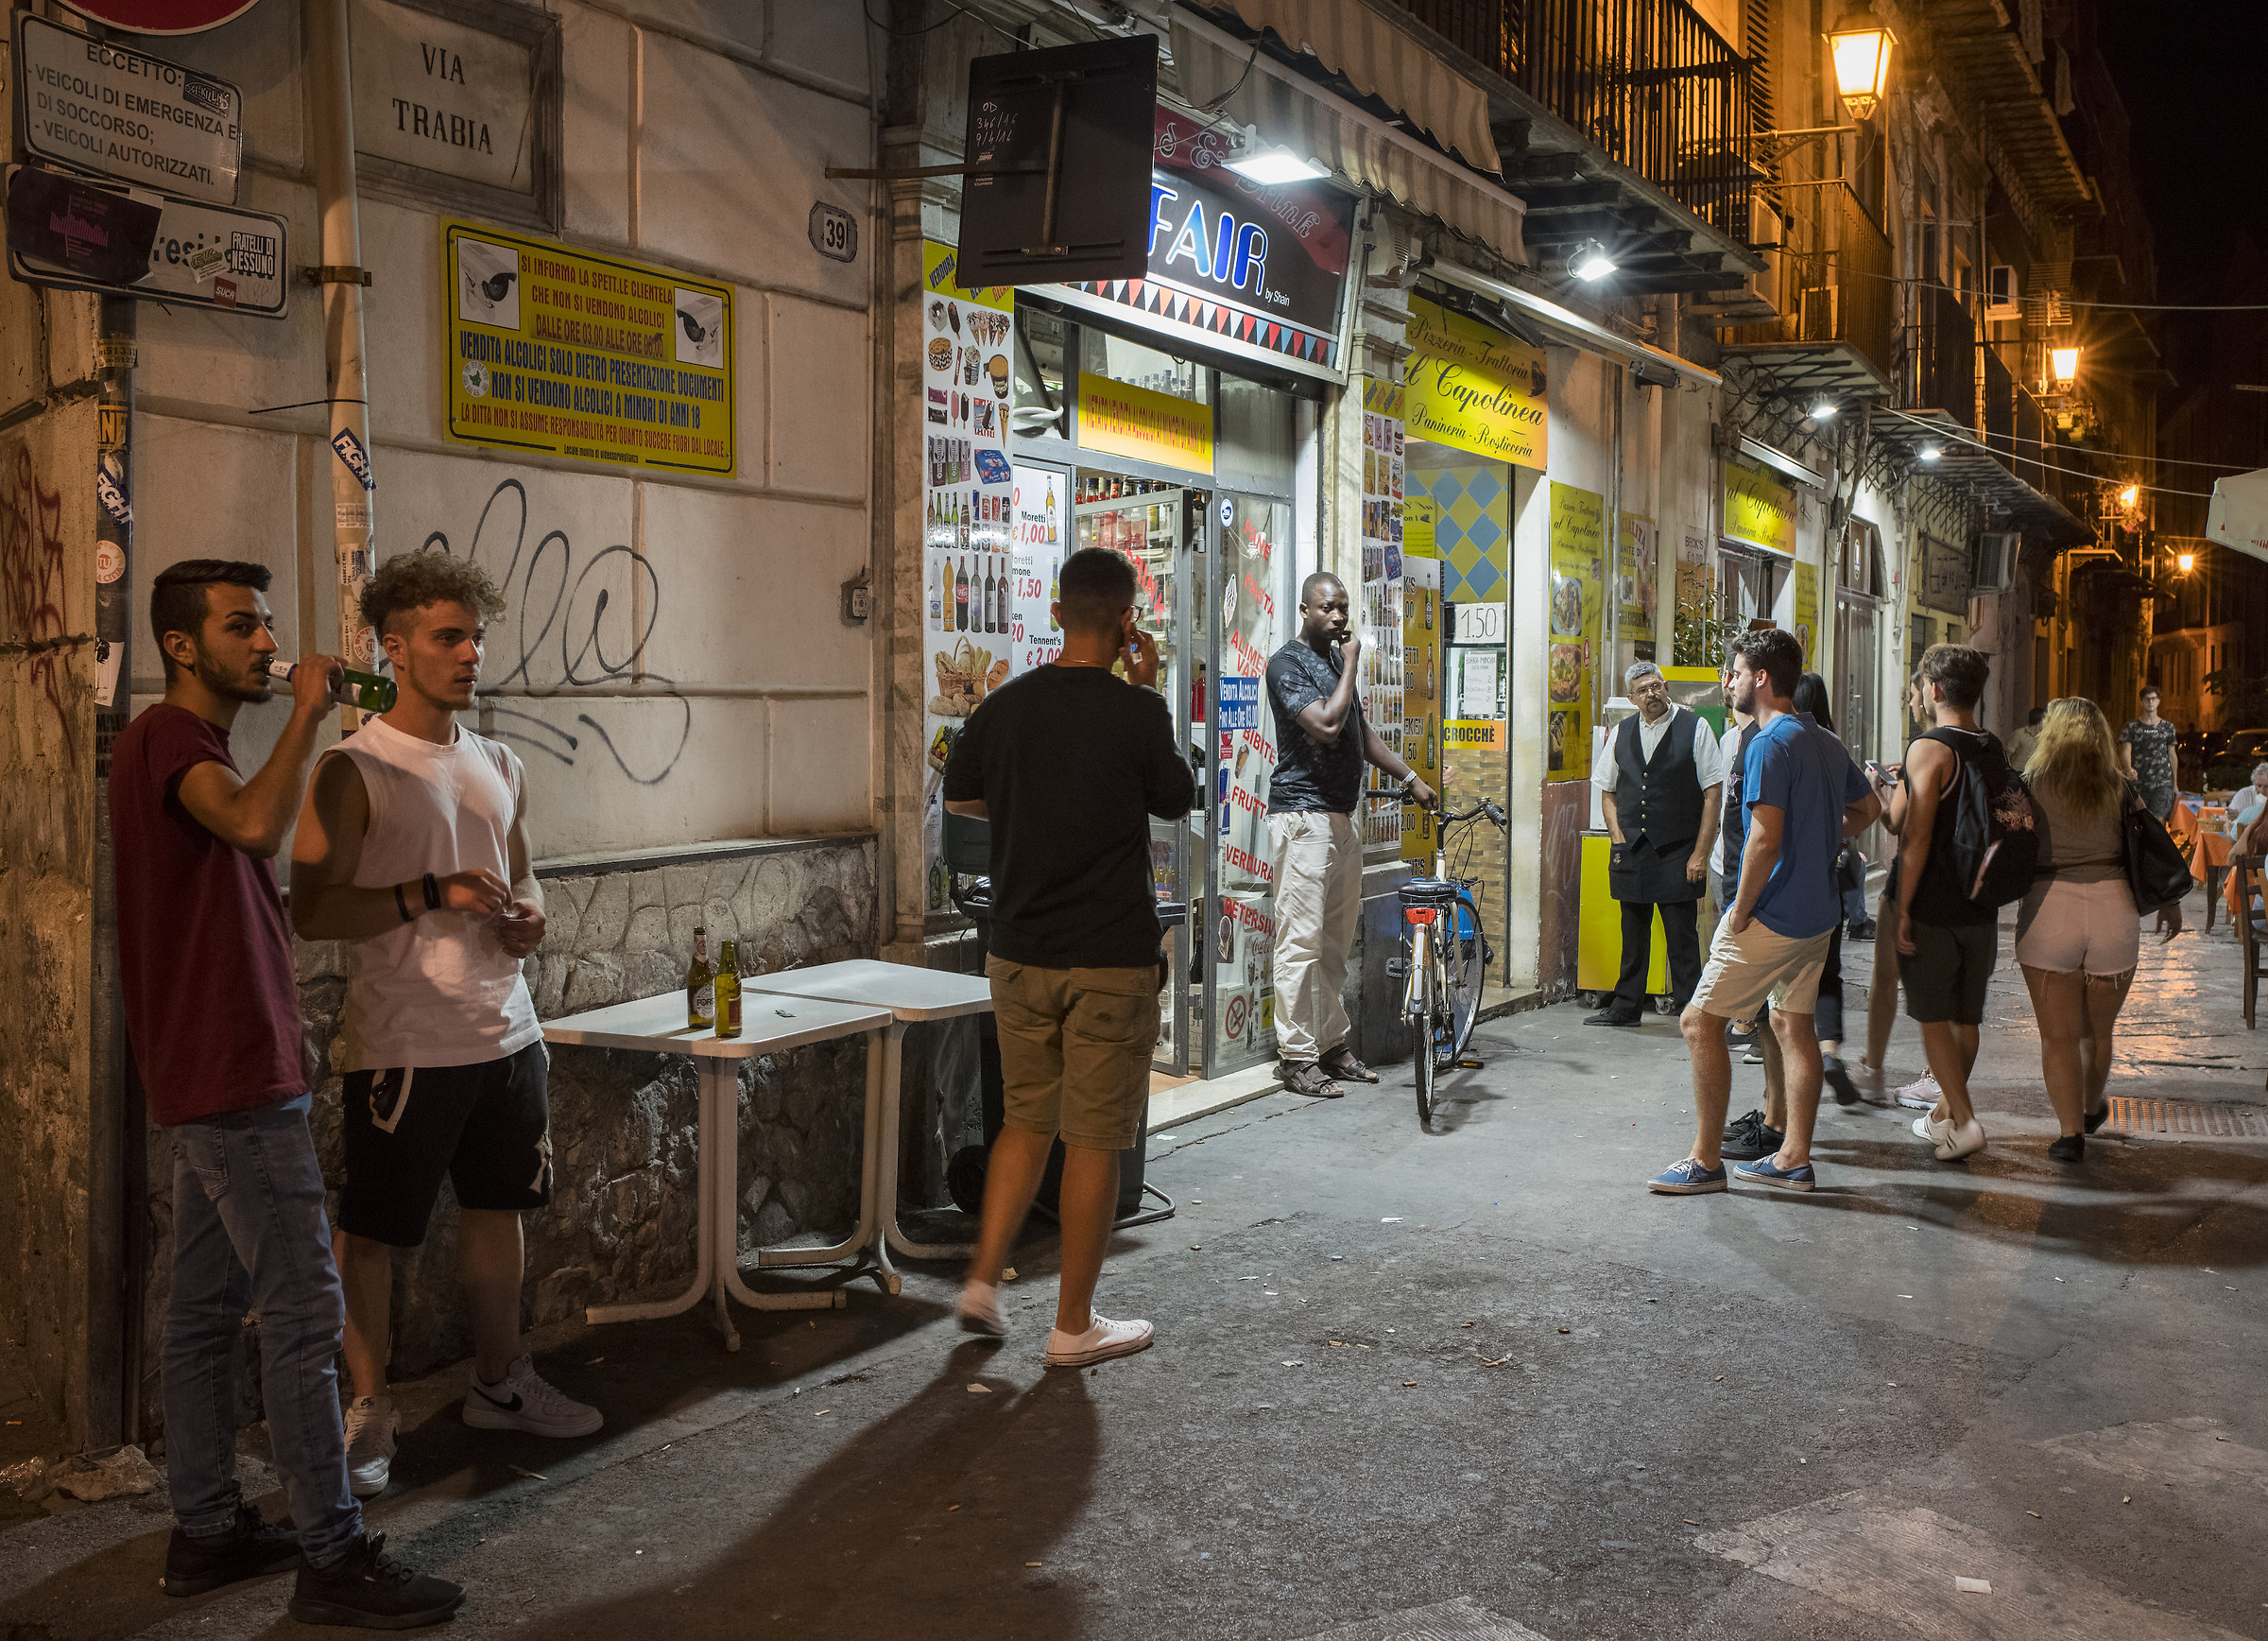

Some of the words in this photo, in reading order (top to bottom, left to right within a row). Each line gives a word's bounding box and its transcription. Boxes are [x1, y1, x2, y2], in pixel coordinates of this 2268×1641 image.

[86, 43, 183, 88] ECCETTO:
[421, 43, 465, 85] VIA
[35, 64, 98, 100] VEICOLI
[103, 87, 119, 107] DI
[125, 91, 224, 137] EMERGENZA
[229, 125, 237, 141] E
[38, 93, 52, 110] DI
[57, 99, 155, 146] SOCCORSO;
[392, 97, 493, 155] TRABIA
[43, 119, 103, 154] VEICOLI
[107, 142, 215, 185] AUTORIZZATI.
[1191, 132, 1225, 169] &
[232, 232, 264, 253] FRATELLI
[266, 238, 275, 255] DI
[827, 219, 845, 250] 39
[232, 250, 274, 275] NESSUNO
[522, 255, 531, 273] SI
[534, 258, 576, 283] INFORMA
[579, 270, 590, 287] LA
[592, 272, 628, 296] SPETT.LE
[631, 281, 673, 305] CLIENTELA
[929, 253, 955, 289] VERDURA
[532, 285, 549, 302] CHE
[553, 289, 571, 309] NON
[574, 294, 583, 311] SI
[586, 297, 626, 320] VENDONO
[628, 305, 664, 329] ALCOLICI
[992, 285, 1011, 302] GELA
[1265, 287, 1273, 299] by
[1274, 288, 1290, 306] Shain
[536, 314, 561, 338] DALLE
[564, 320, 580, 342] ORE
[606, 328, 625, 350] ALLE
[627, 333, 642, 354] ORE
[1410, 313, 1467, 358] Pizzeria
[1475, 340, 1528, 381] Trattoria
[460, 331, 501, 364] VENDITA
[505, 338, 547, 371] ALCOLICI
[550, 348, 573, 375] SOLO
[576, 353, 607, 383] DIETRO
[610, 358, 675, 395] PRESENTAZIONE
[678, 372, 724, 403] DOCUMENTI
[491, 371, 511, 400] NON
[515, 375, 524, 403] SI
[528, 377, 571, 410] VENDONO
[574, 384, 612, 416] ALCOLICI
[615, 390, 622, 418] A
[625, 393, 656, 423] MINORI
[659, 401, 667, 425] DI
[670, 402, 691, 428] ANNI
[692, 406, 700, 430] 18
[1435, 356, 1545, 427] Capolinea
[461, 403, 471, 422] LA
[472, 406, 492, 425] DITTA
[494, 408, 508, 427] NON
[511, 410, 518, 428] SI
[520, 411, 548, 434] ASSUME
[550, 416, 604, 441] RESPONSABILITÀ
[606, 424, 617, 442] PER
[619, 426, 643, 447] QUANTO
[644, 430, 671, 450] SUCCEDE
[673, 435, 691, 453] FUORI
[692, 437, 702, 455] DAL
[704, 439, 724, 458] LOCALE
[1413, 403, 1467, 440] Panineria
[1474, 423, 1534, 458] Rosticceria
[1022, 510, 1046, 523] Moretti
[1745, 478, 1796, 525] Capolinea
[1022, 523, 1045, 545] 1,00
[1244, 519, 1271, 561] PANE
[1620, 544, 1635, 556] ANITE
[1012, 568, 1031, 577] mone
[1013, 556, 1033, 566] oretti
[1620, 557, 1637, 568] ICILIA
[1018, 579, 1041, 601] 1,50
[1244, 572, 1275, 620] PASTA
[1029, 634, 1061, 646] Tennent's
[1461, 608, 1497, 639] 1.50
[1026, 650, 1033, 666] €
[1231, 630, 1267, 677] ALIMEN
[1219, 679, 1238, 701] VENDITA
[1239, 680, 1258, 701] ALCOLICI
[1243, 728, 1277, 767] BIBITE
[1444, 725, 1495, 743] CROCCHÈ
[1226, 843, 1274, 884] VERDURA
